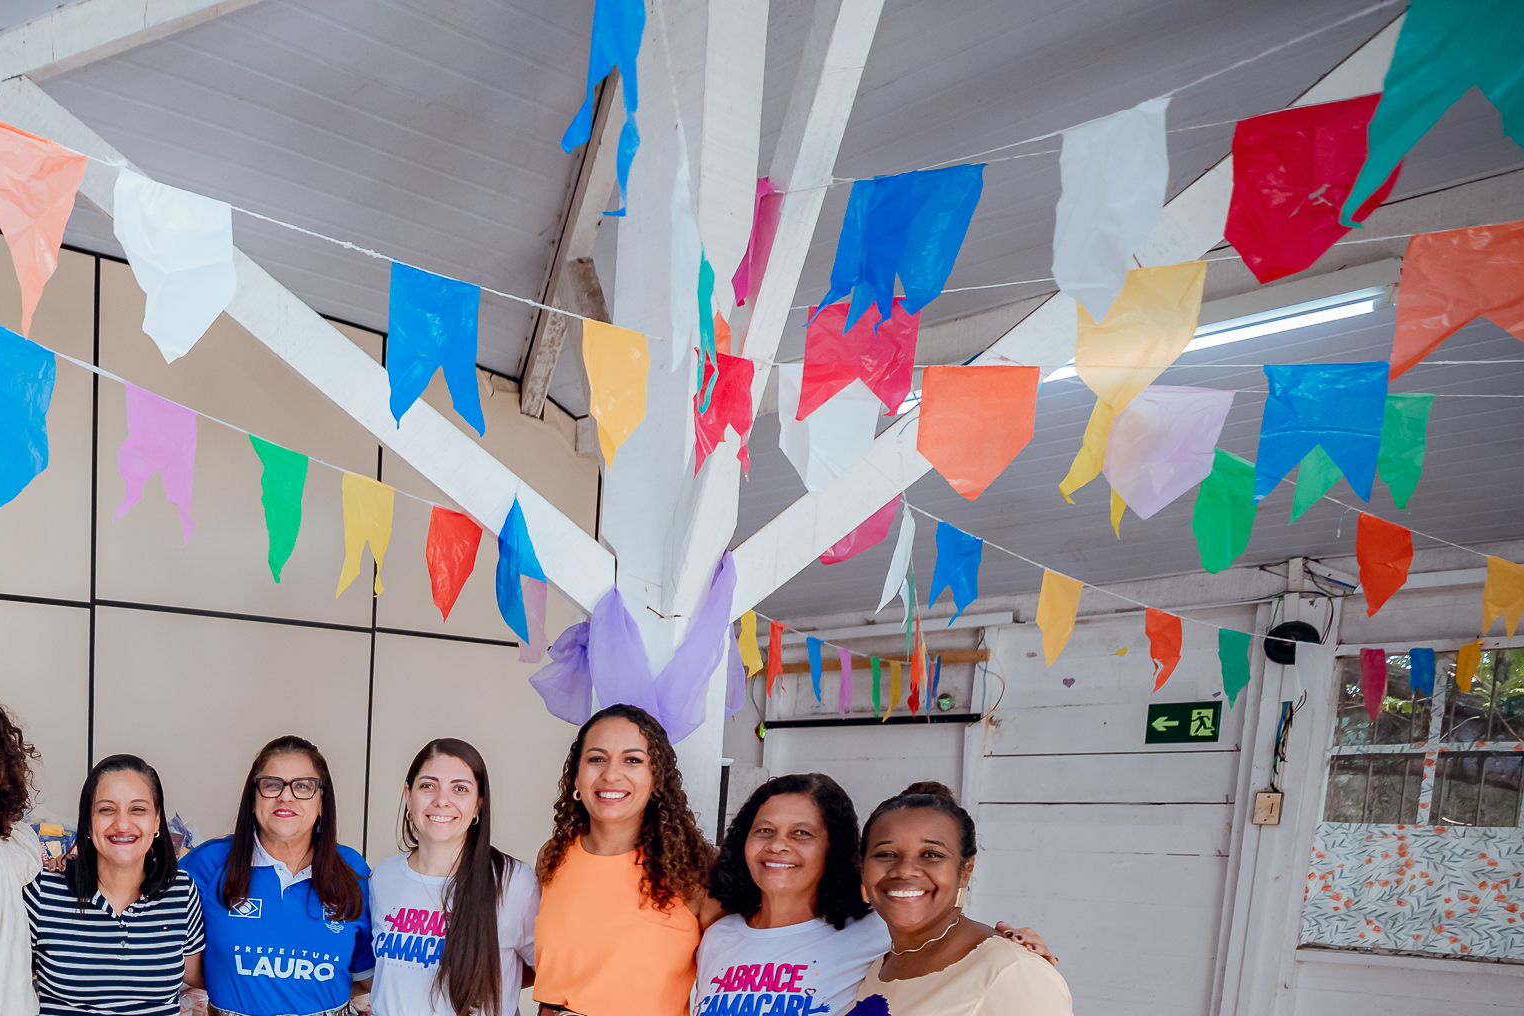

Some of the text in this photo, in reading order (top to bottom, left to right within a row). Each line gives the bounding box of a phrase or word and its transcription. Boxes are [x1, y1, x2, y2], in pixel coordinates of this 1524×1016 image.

[384, 907, 452, 938] ABRAC
[234, 945, 340, 963] PREFEITURA
[375, 931, 445, 969] CAMAÇA
[234, 954, 335, 982] LAURO
[710, 962, 809, 994] ABRACE
